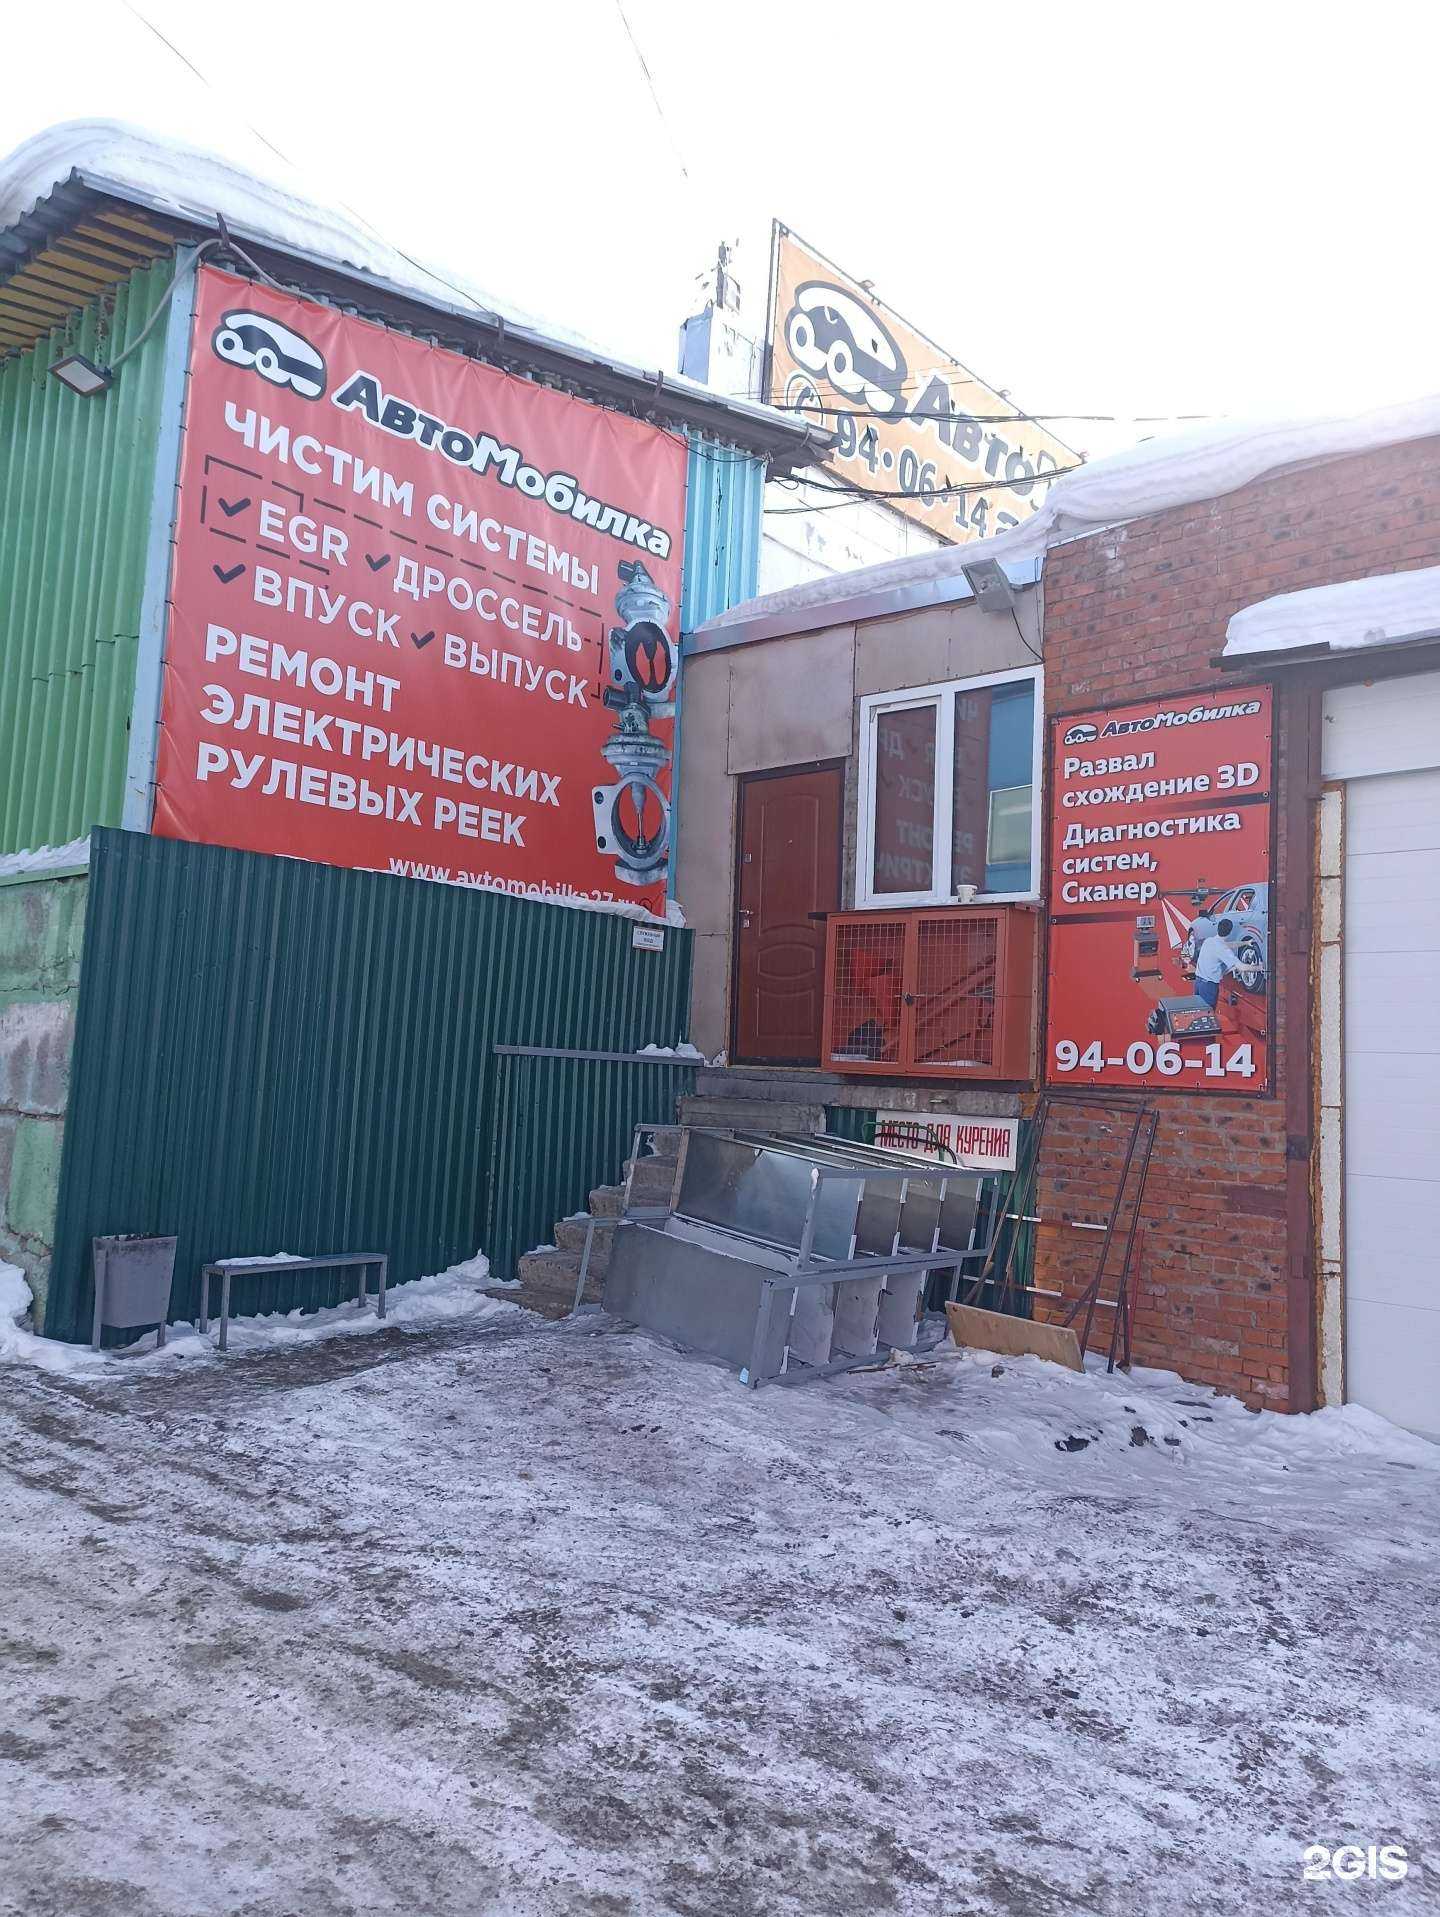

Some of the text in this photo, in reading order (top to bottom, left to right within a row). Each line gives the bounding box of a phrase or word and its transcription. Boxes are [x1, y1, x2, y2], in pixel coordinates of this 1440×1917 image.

[224, 400, 599, 595] ЧИСТИМ СИСТЕМЫ
[332, 369, 671, 560] АвтоМобилка
[259, 500, 349, 567] EGR
[253, 566, 402, 648] ВПУСК
[393, 555, 583, 653] ДРОССЕЛЬ
[205, 623, 401, 713] РЕМОНТ
[443, 633, 588, 708] ВЫПУСК
[200, 684, 562, 807] ЭЛЕКТРИЧЕСКИХ
[1100, 700, 1261, 738] АвтоМобилка
[196, 741, 527, 847] РУЛЕВЫХ РЕЕК
[1062, 762, 1259, 808] схождение 3D
[1063, 751, 1155, 779] Развал
[1062, 812, 1240, 850] Диагностика
[1062, 851, 1158, 875] систем,
[1062, 881, 1157, 904] Сканер
[1055, 1040, 1256, 1077] 94-06-14
[956, 1125, 1011, 1158] КУРЕНИЯ
